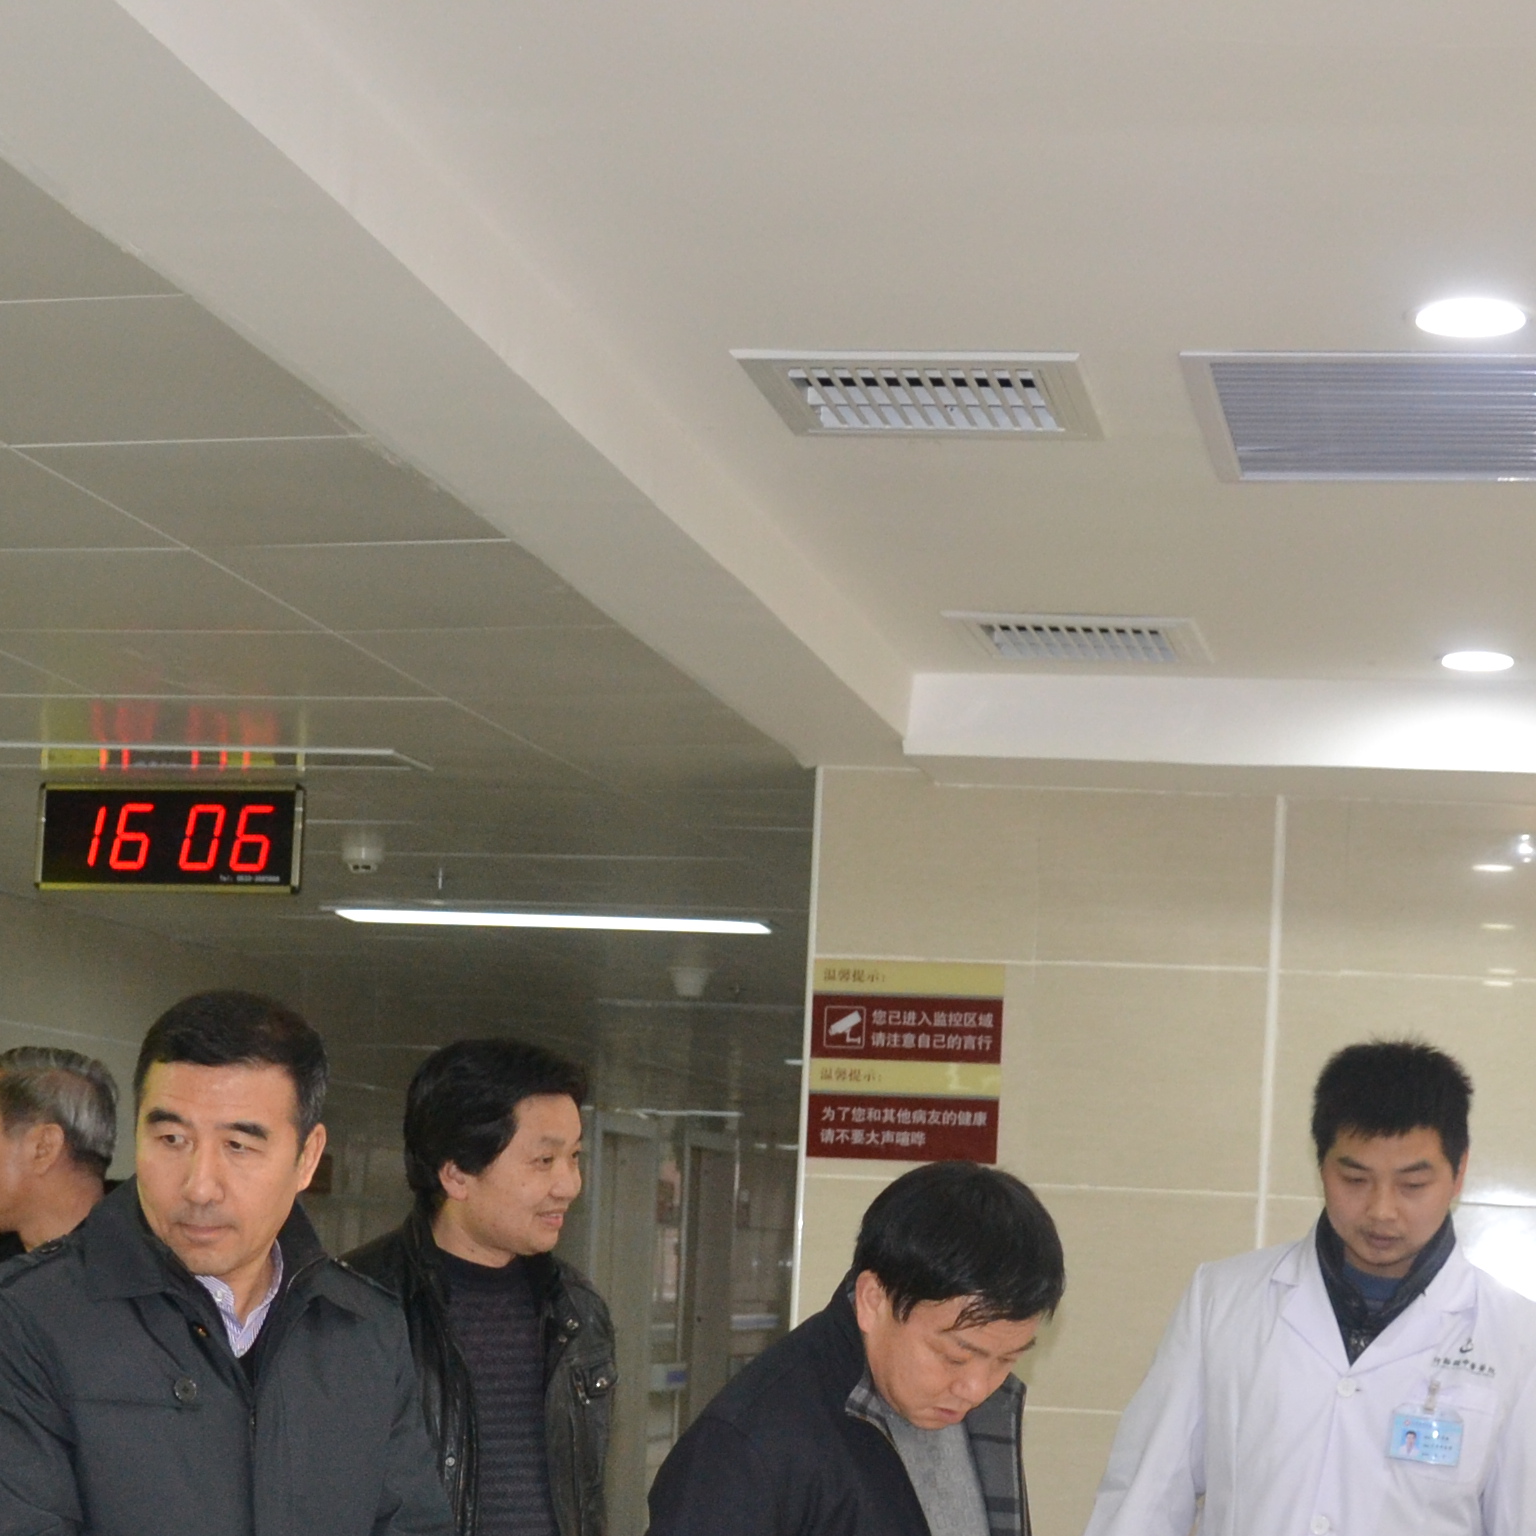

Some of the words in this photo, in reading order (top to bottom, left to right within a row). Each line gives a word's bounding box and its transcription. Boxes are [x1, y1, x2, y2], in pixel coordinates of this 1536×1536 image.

[87, 803, 154, 870] 16
[178, 804, 275, 872] 06
[872, 1009, 994, 1028] 您已进入监控区域
[871, 1034, 993, 1051] 请注意自己的言行
[821, 1106, 987, 1127] 为了您和其他病友的健康
[820, 1129, 926, 1147] 请不要大声喧哗
